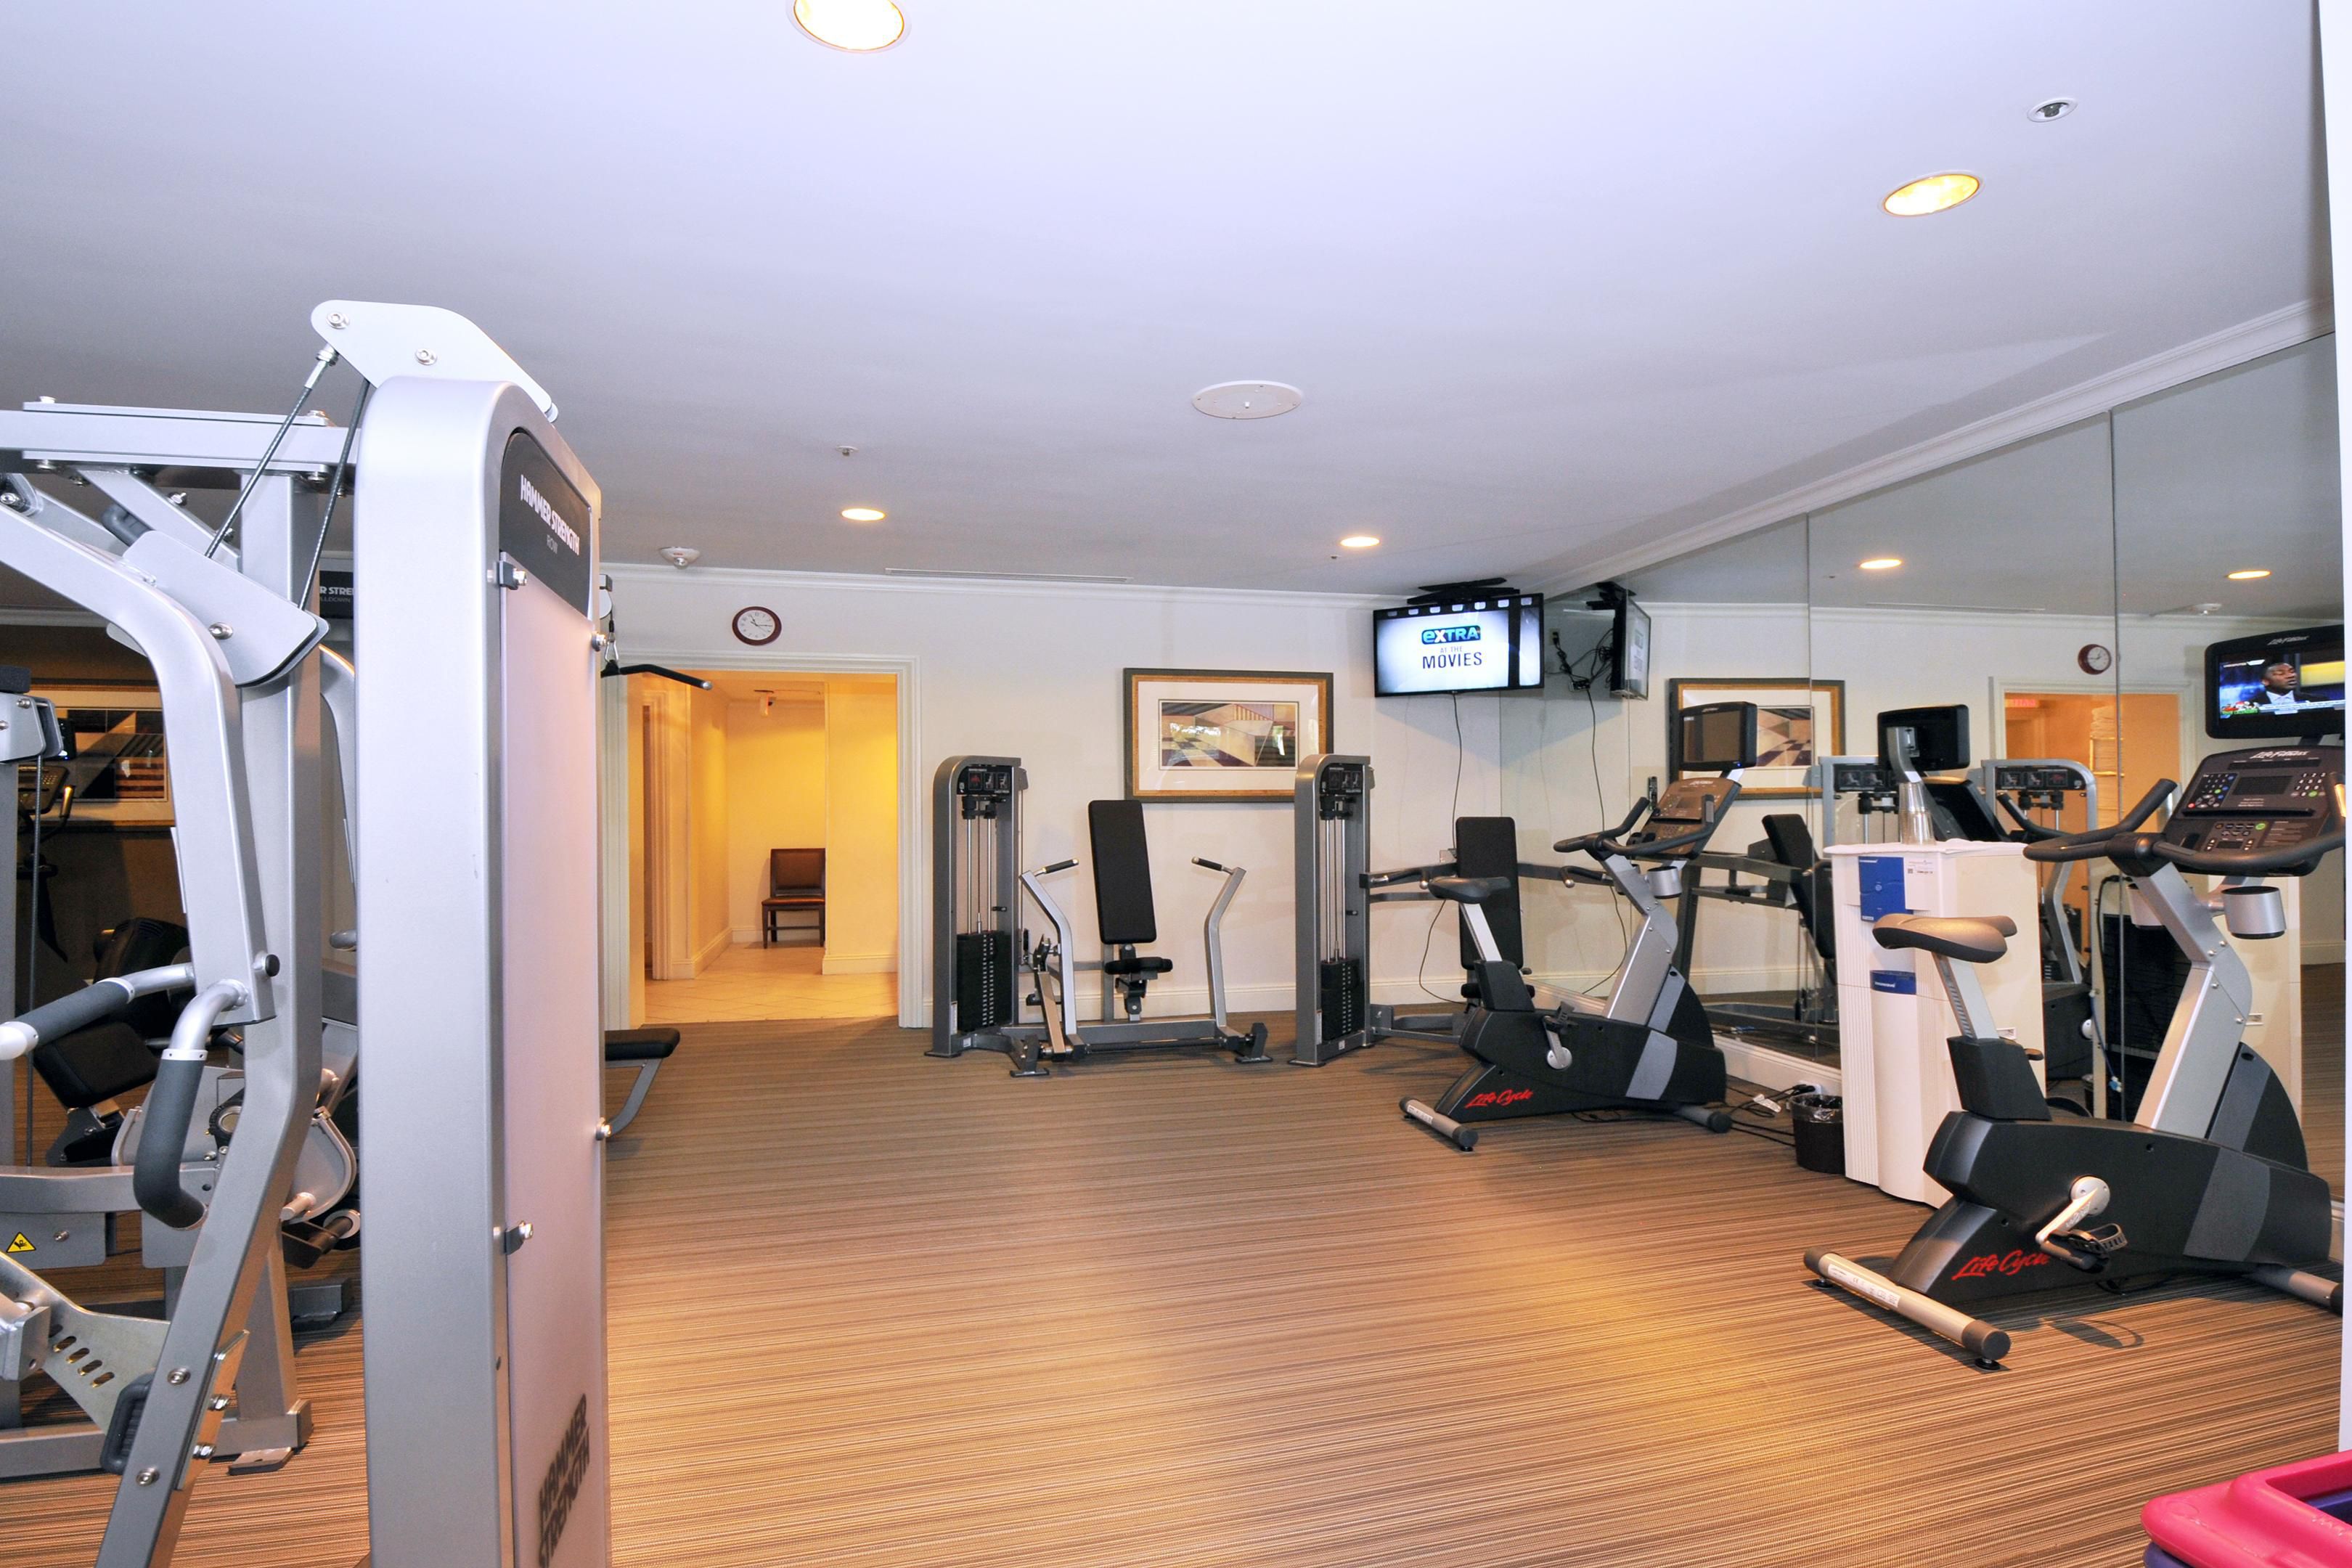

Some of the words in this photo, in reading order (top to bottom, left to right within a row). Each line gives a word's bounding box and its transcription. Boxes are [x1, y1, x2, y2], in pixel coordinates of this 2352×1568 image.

[520, 474, 552, 527] HAMMER
[551, 510, 580, 556] STRENGTH
[328, 586, 354, 595] STRE
[1423, 652, 1482, 669] MOVIES
[1464, 1092, 1496, 1109] Life
[1951, 1254, 1998, 1281] Life
